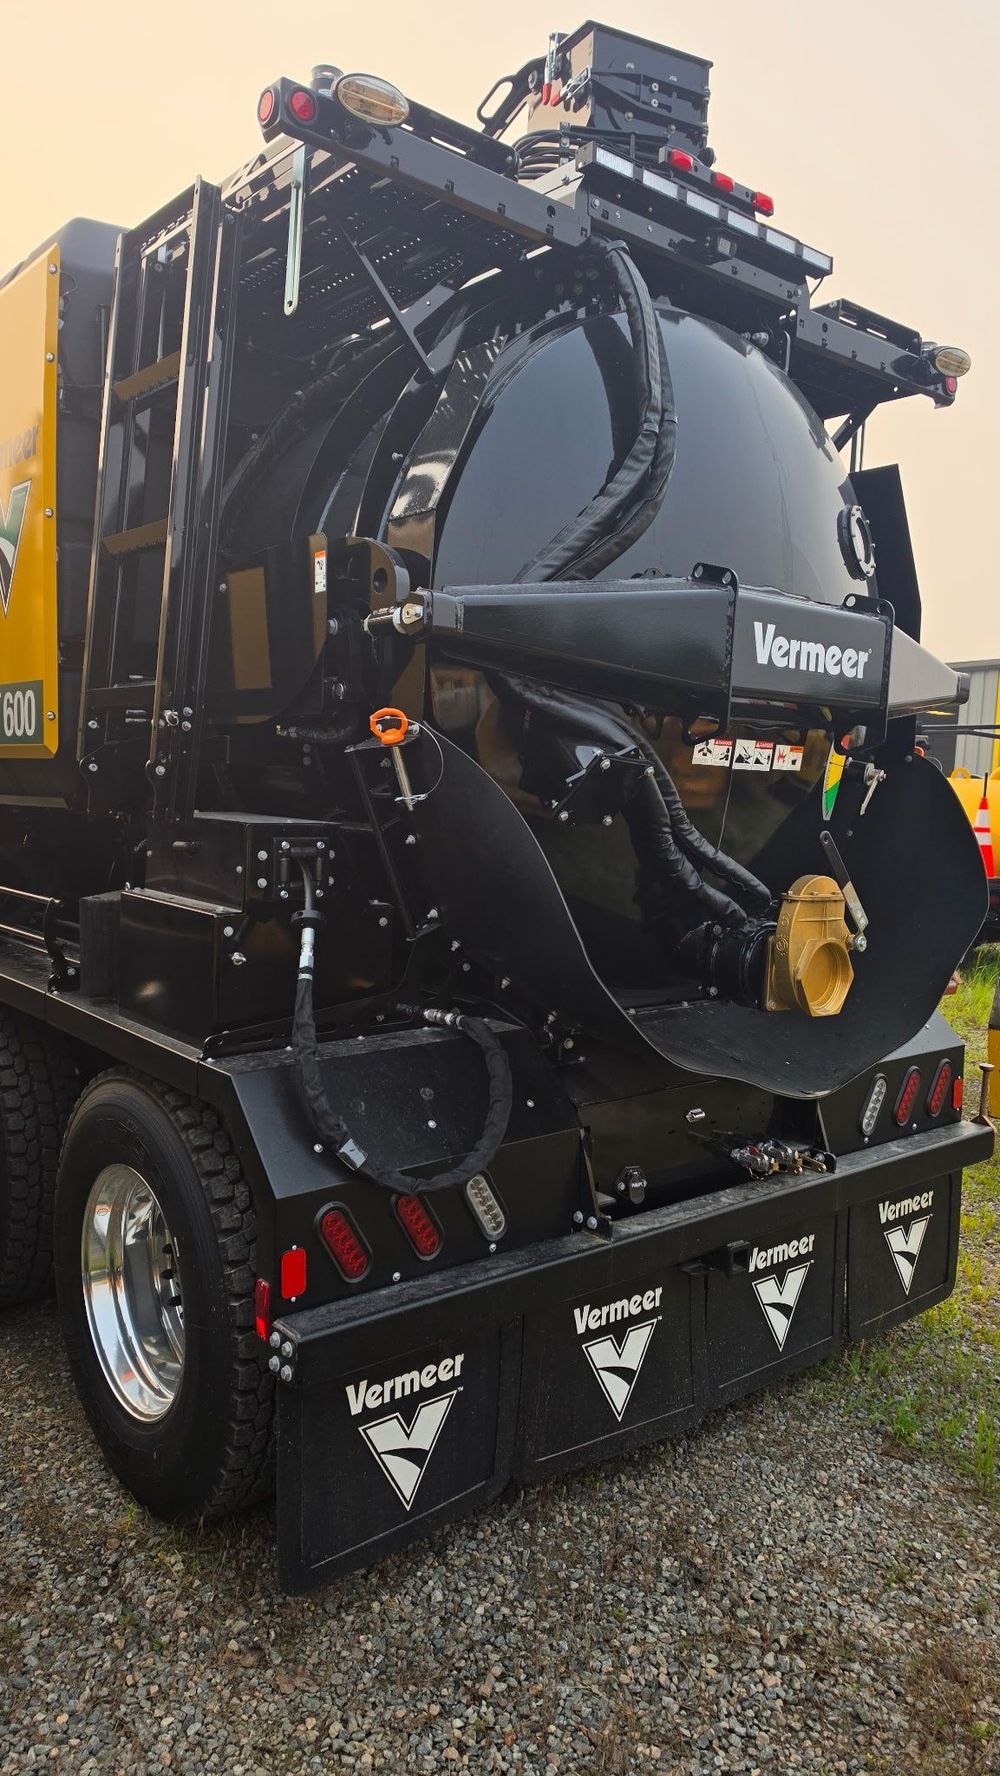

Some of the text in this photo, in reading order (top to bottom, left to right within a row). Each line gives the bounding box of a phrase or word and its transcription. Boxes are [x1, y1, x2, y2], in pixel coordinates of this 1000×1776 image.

[753, 621, 869, 679] Vermeer
[3, 689, 36, 737] 600
[878, 1190, 934, 1224] Vermeer
[573, 1286, 663, 1335] Vermeer
[345, 1353, 465, 1416] Vermeer
